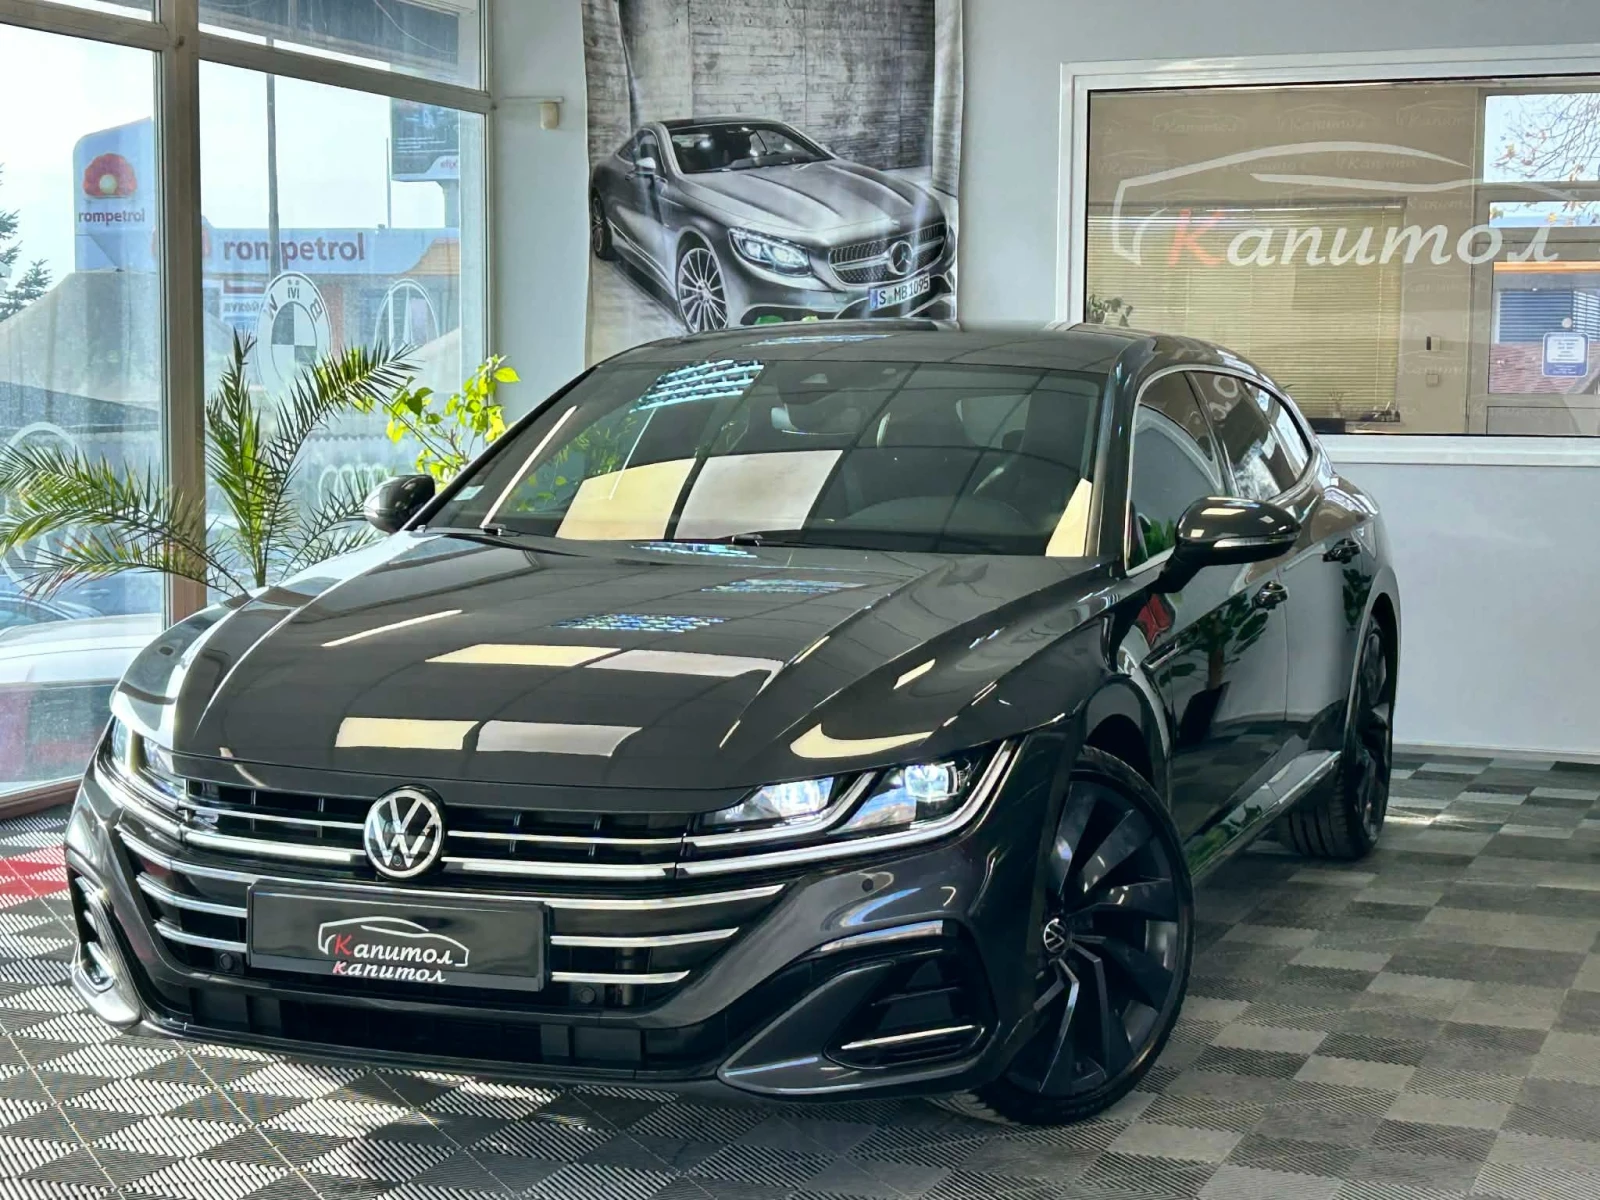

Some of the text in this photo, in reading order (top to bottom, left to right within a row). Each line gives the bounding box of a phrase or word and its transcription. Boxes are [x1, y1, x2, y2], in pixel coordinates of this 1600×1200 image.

[78, 208, 145, 227] rompetrol
[1168, 208, 1561, 267] Капитол
[333, 933, 453, 965] Капитол
